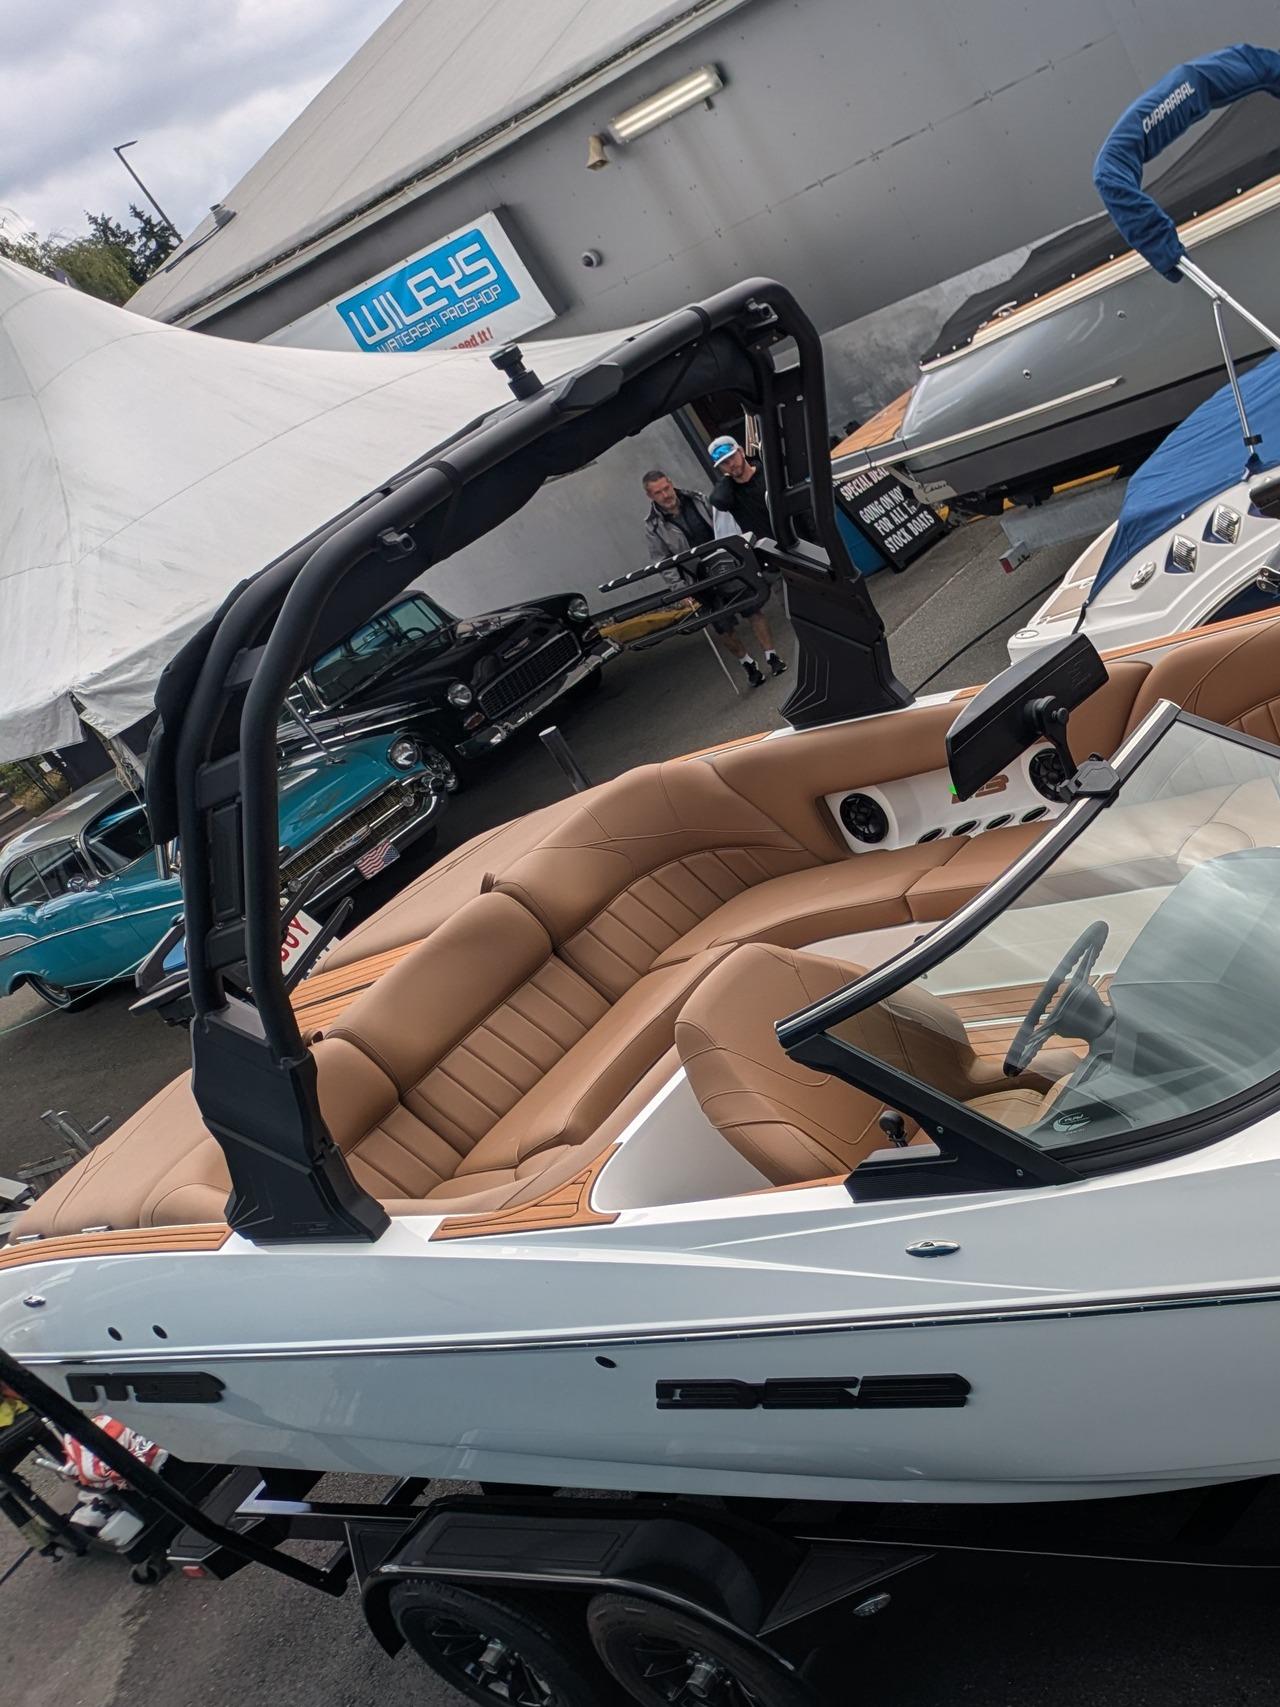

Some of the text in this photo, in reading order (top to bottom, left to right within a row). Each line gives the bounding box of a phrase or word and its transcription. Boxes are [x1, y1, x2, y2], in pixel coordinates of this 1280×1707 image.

[1141, 81, 1195, 134] CHAPARRAL
[349, 242, 498, 345] WILEYS
[439, 284, 501, 325] PROSHOP
[840, 466, 890, 501] SPECIAL DEAL
[859, 500, 883, 525] GOING
[879, 494, 894, 512] ON
[874, 519, 895, 536] FOR
[893, 506, 909, 529] ALL
[884, 510, 935, 554] STOCK BOATS
